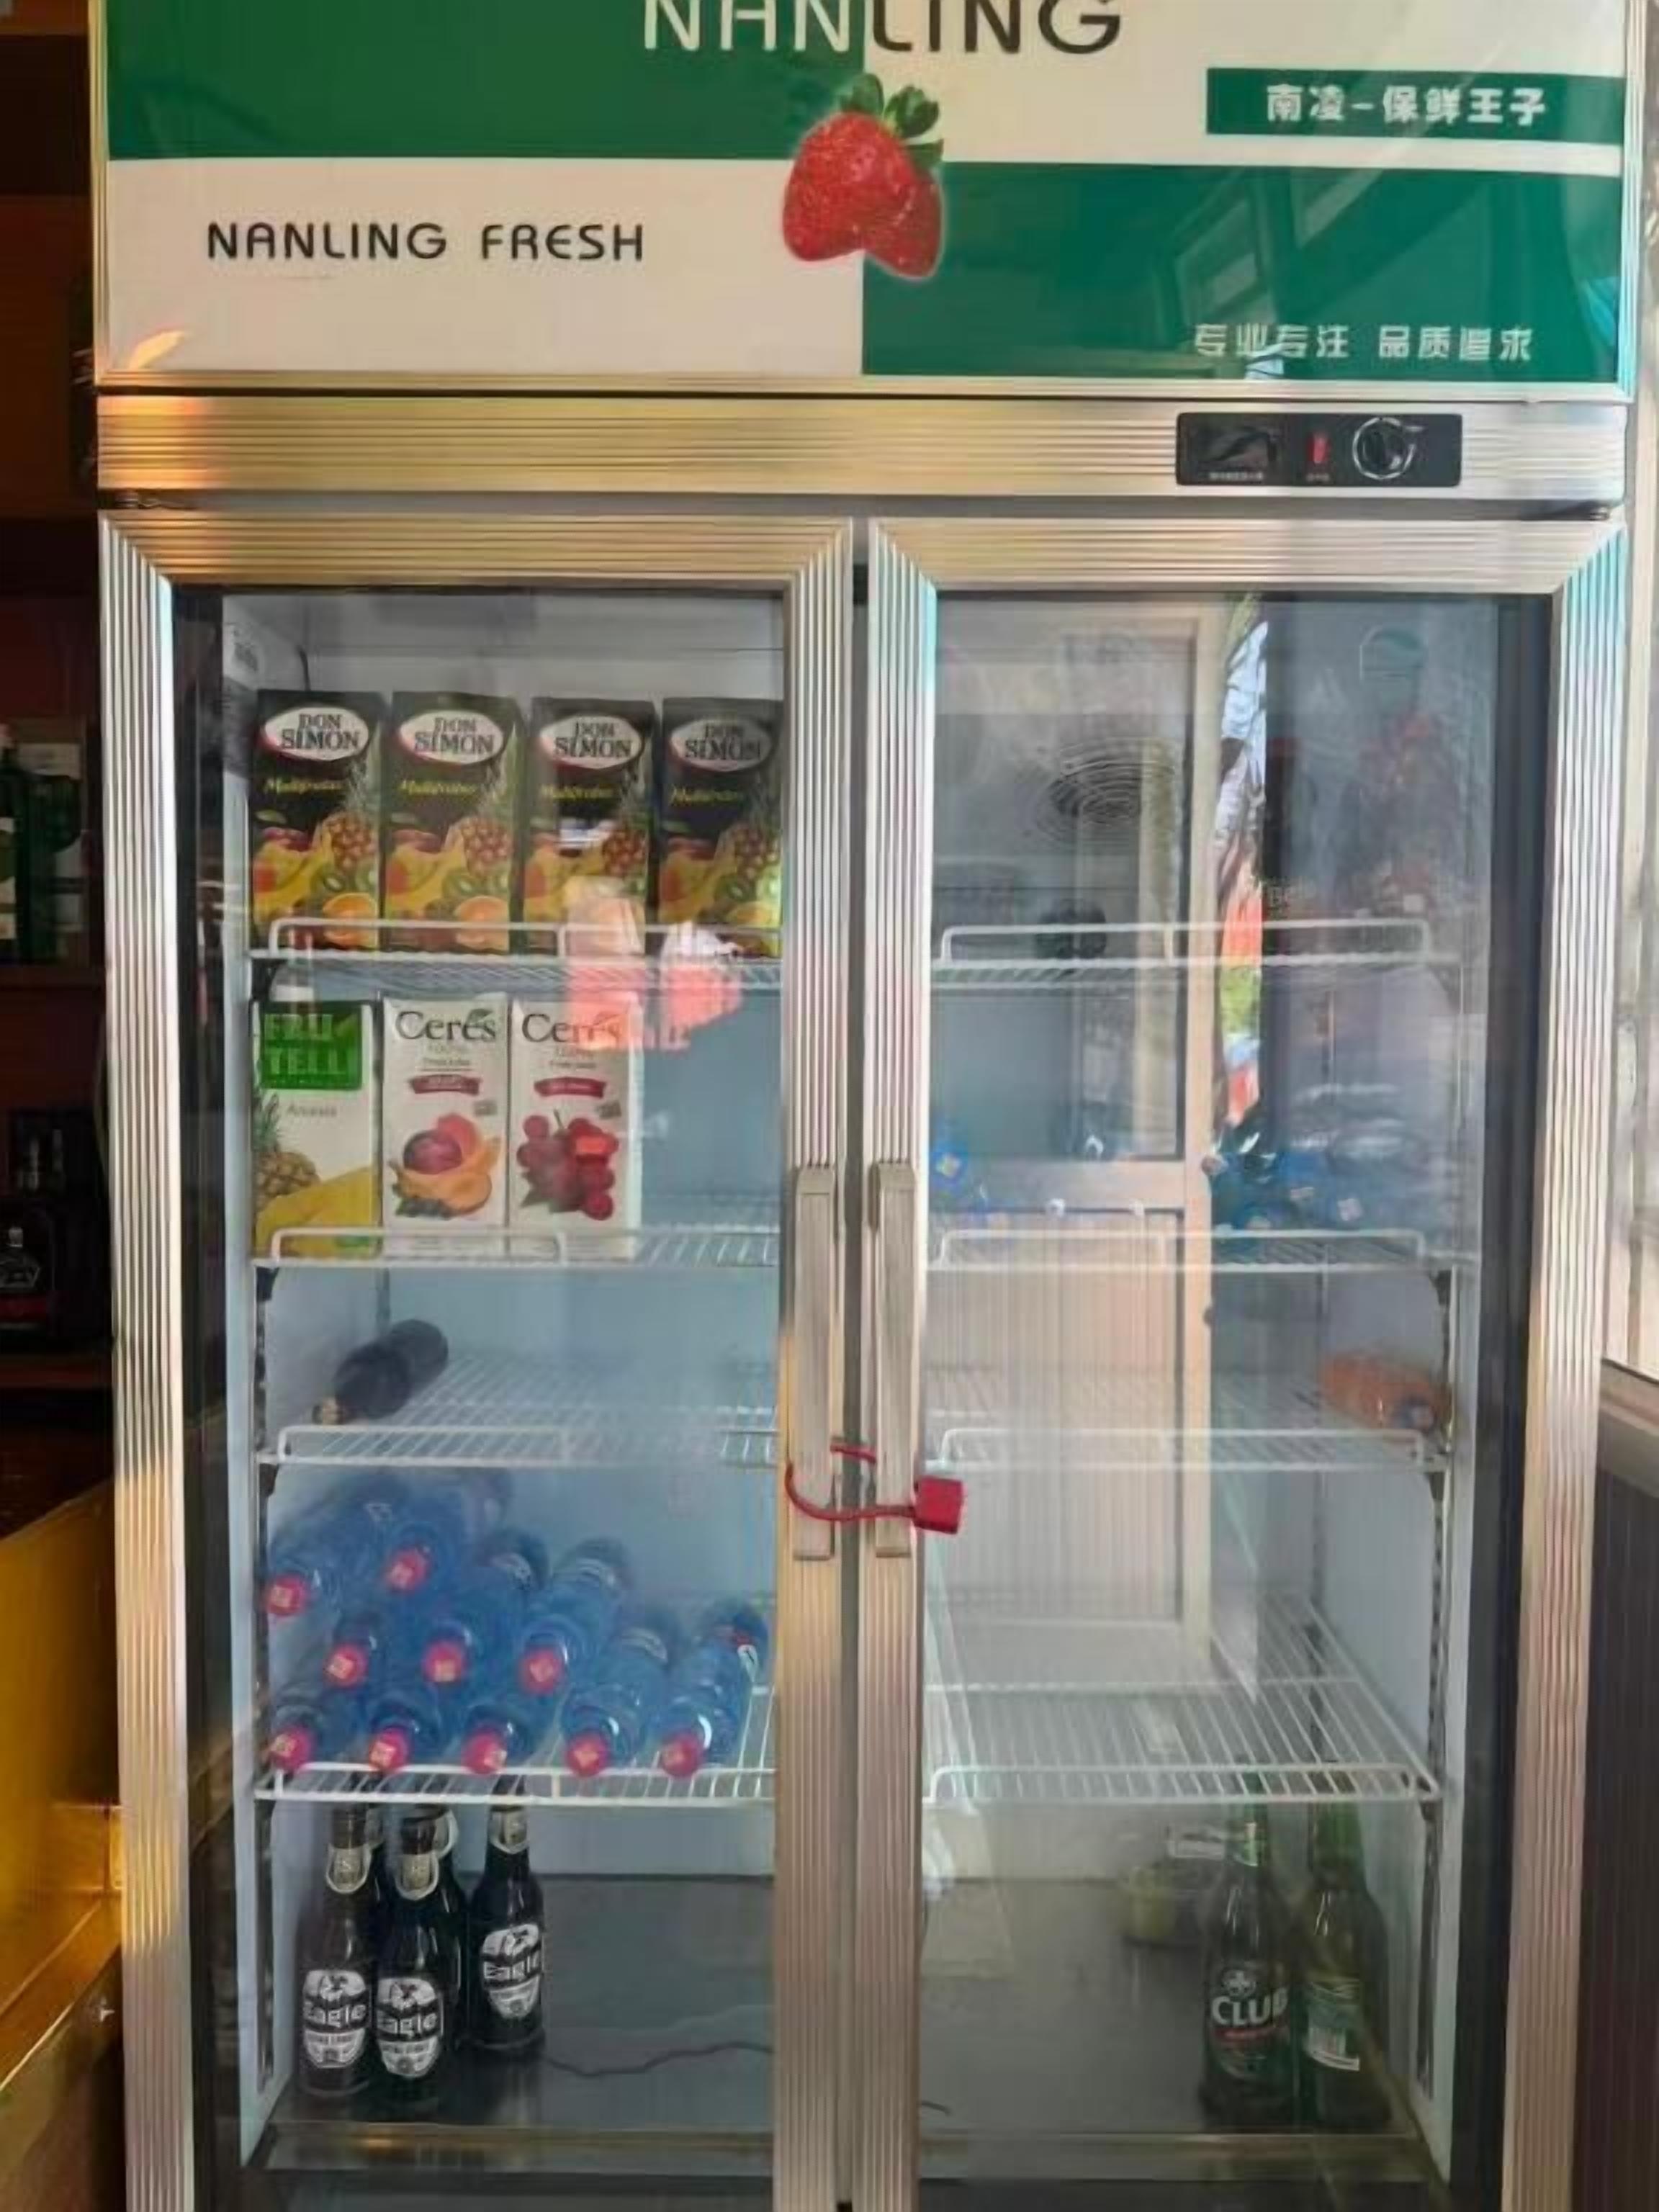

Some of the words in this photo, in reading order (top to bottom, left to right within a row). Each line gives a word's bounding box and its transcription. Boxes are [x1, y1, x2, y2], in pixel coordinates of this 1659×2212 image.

[643, 0, 1123, 55] NANLING
[207, 222, 447, 260] NANLING
[480, 223, 644, 261] FRESH
[297, 713, 343, 730] DON
[281, 729, 360, 750] SIMON
[413, 732, 495, 753] SIMON
[553, 737, 633, 758] SIMON
[395, 1010, 497, 1041] Ceres
